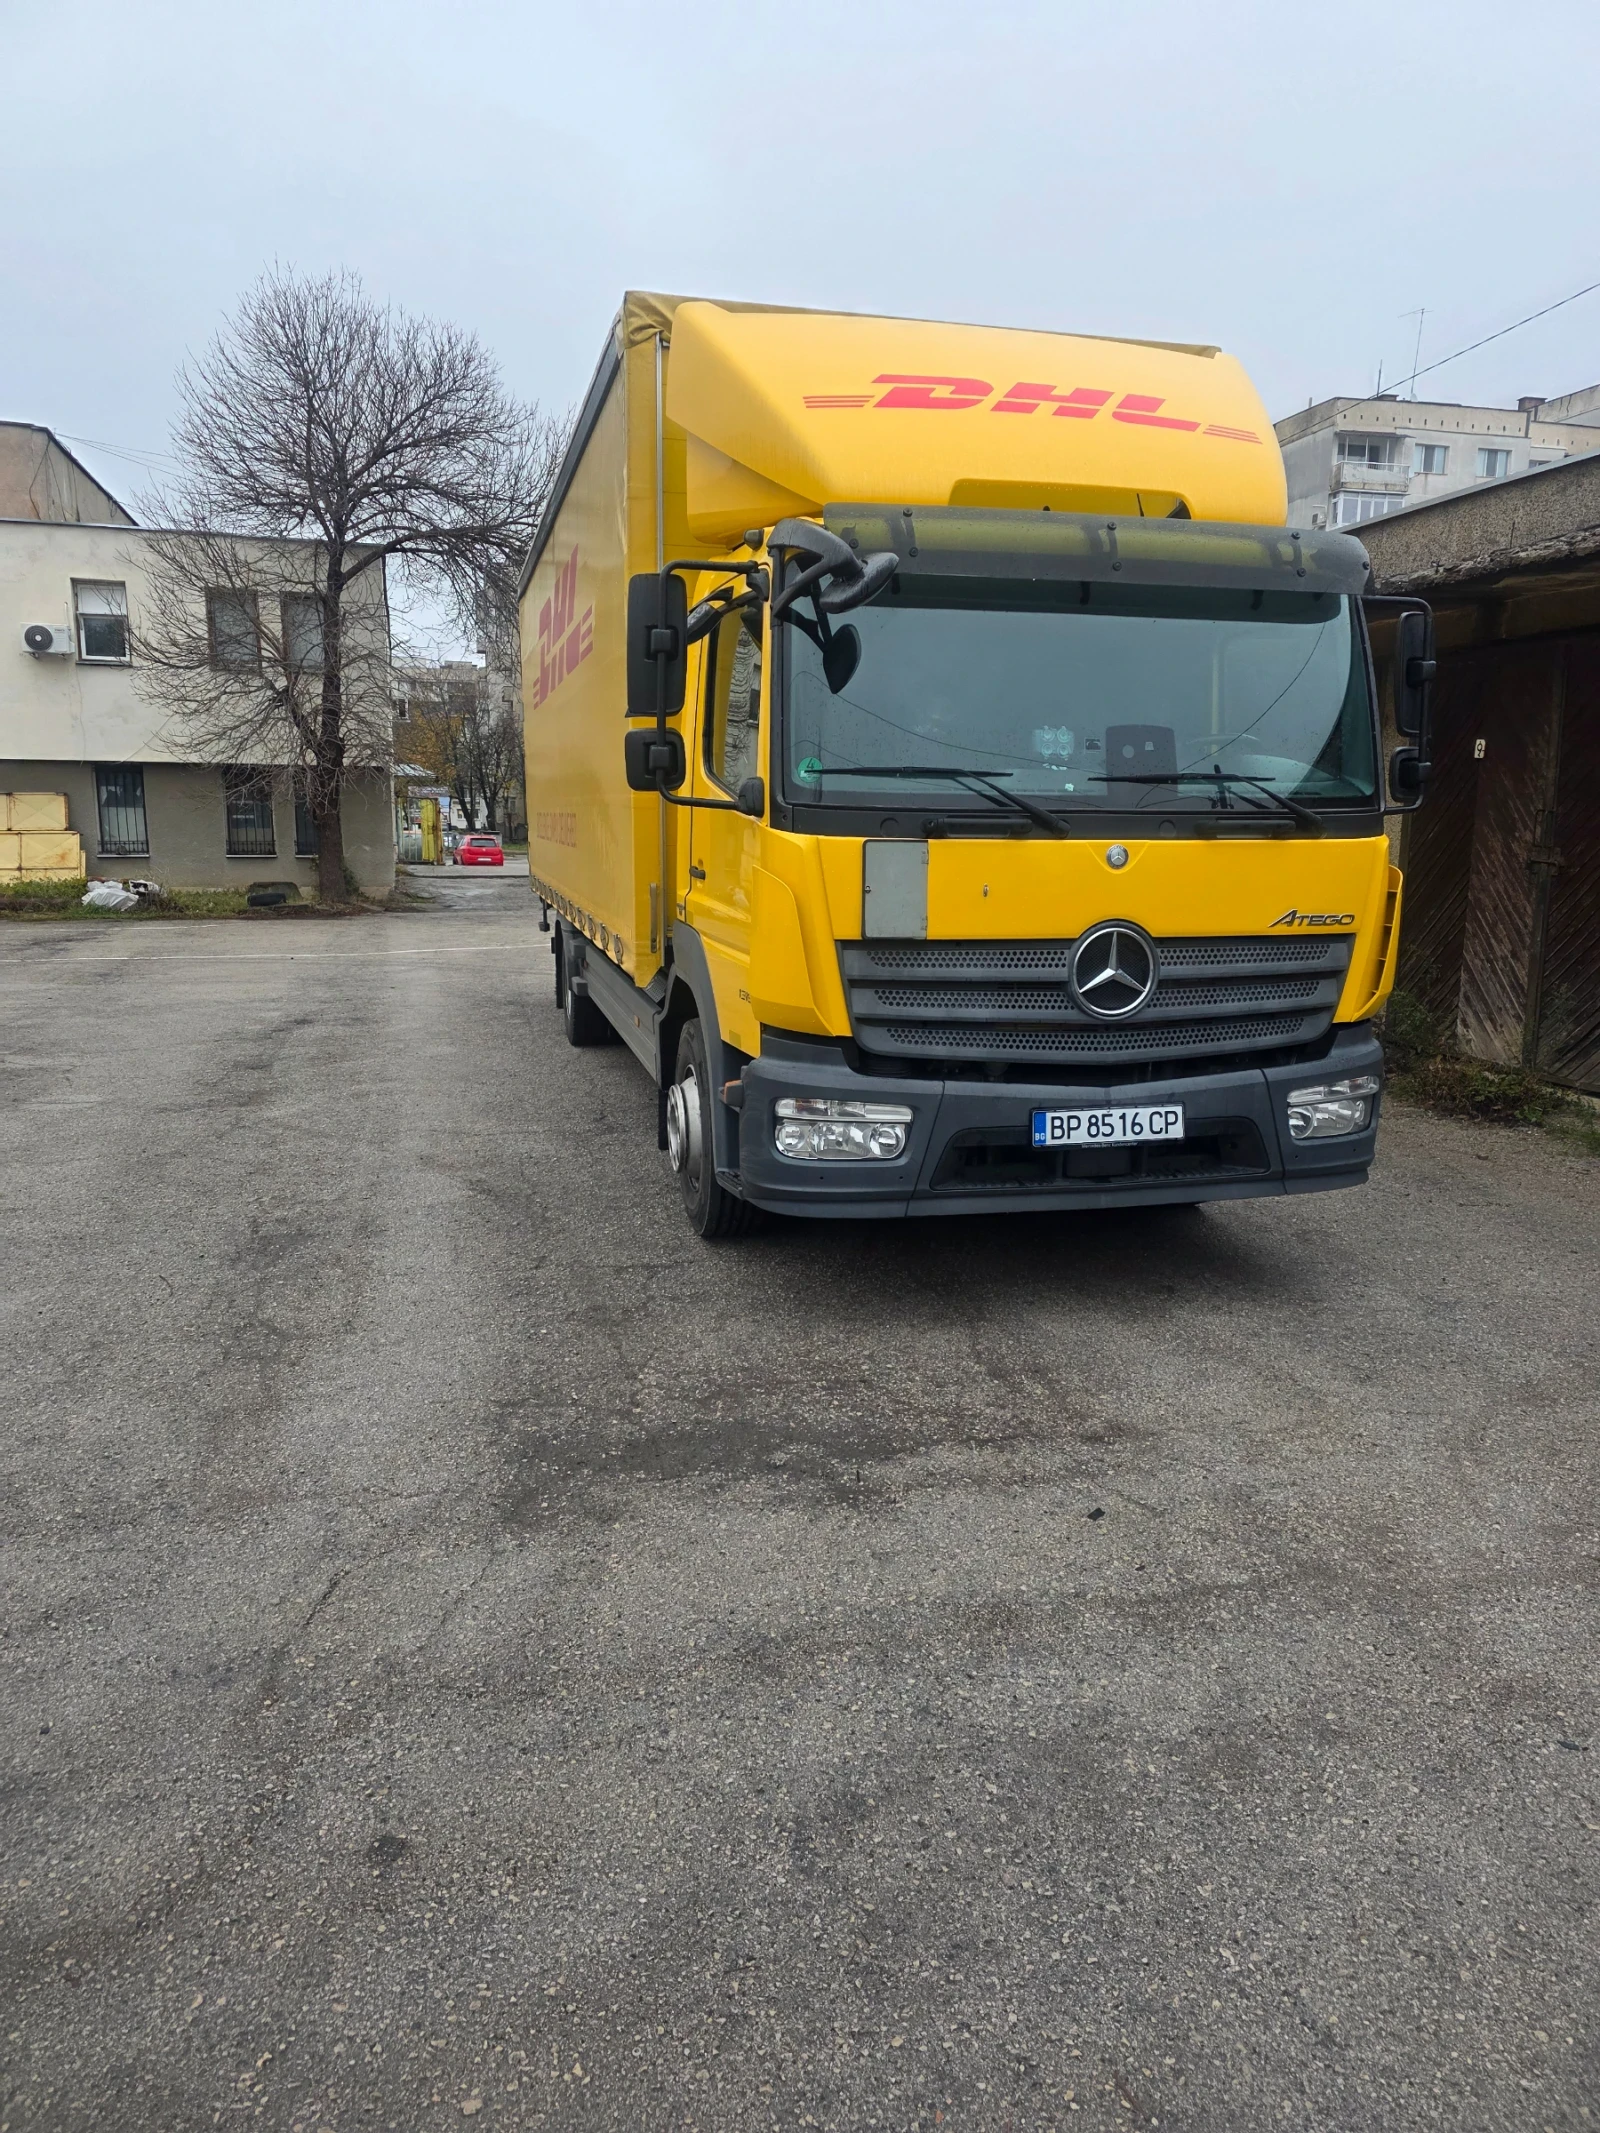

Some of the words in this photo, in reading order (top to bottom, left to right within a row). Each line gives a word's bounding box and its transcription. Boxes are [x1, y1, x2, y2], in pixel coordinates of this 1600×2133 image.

[871, 374, 1202, 432] DHL
[538, 543, 582, 706] DHL
[806, 758, 815, 770] 4
[1034, 1133, 1046, 1141] BG
[1051, 1115, 1081, 1140] BP
[1087, 1111, 1144, 1138] 8516
[1149, 1110, 1179, 1134] CP
